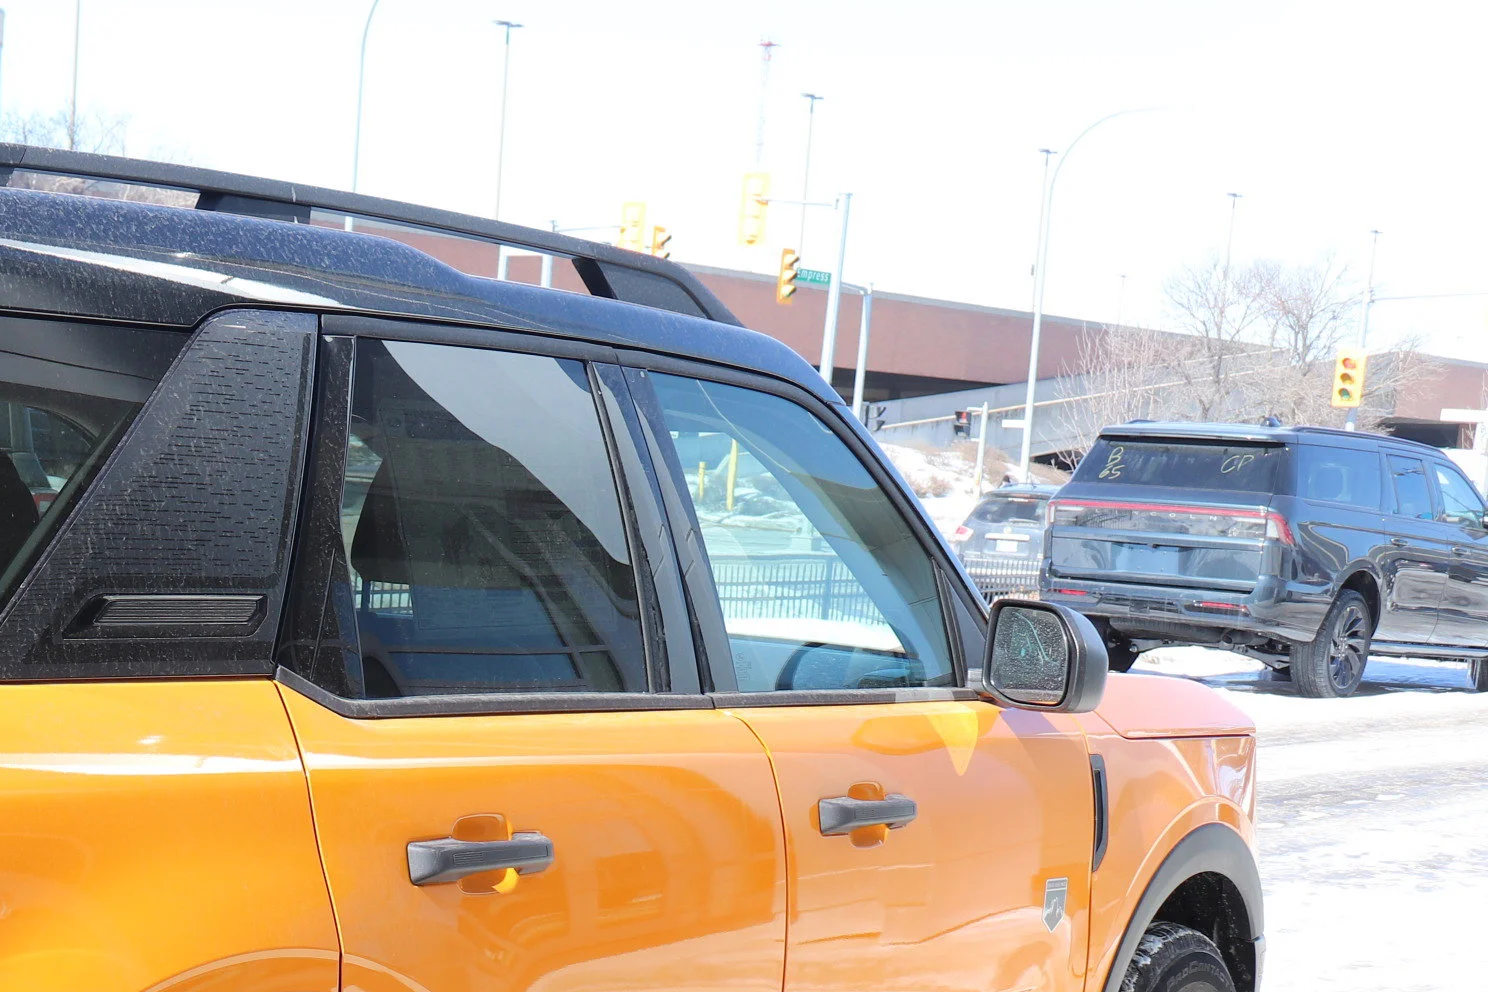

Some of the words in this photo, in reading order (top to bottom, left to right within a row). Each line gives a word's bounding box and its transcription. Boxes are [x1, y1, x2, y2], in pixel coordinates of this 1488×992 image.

[797, 269, 829, 282] Empress
[1107, 446, 1124, 466] B
[1220, 454, 1255, 474] CP
[1098, 465, 1124, 480] 65
[1095, 508, 1218, 521] LINCOLN
